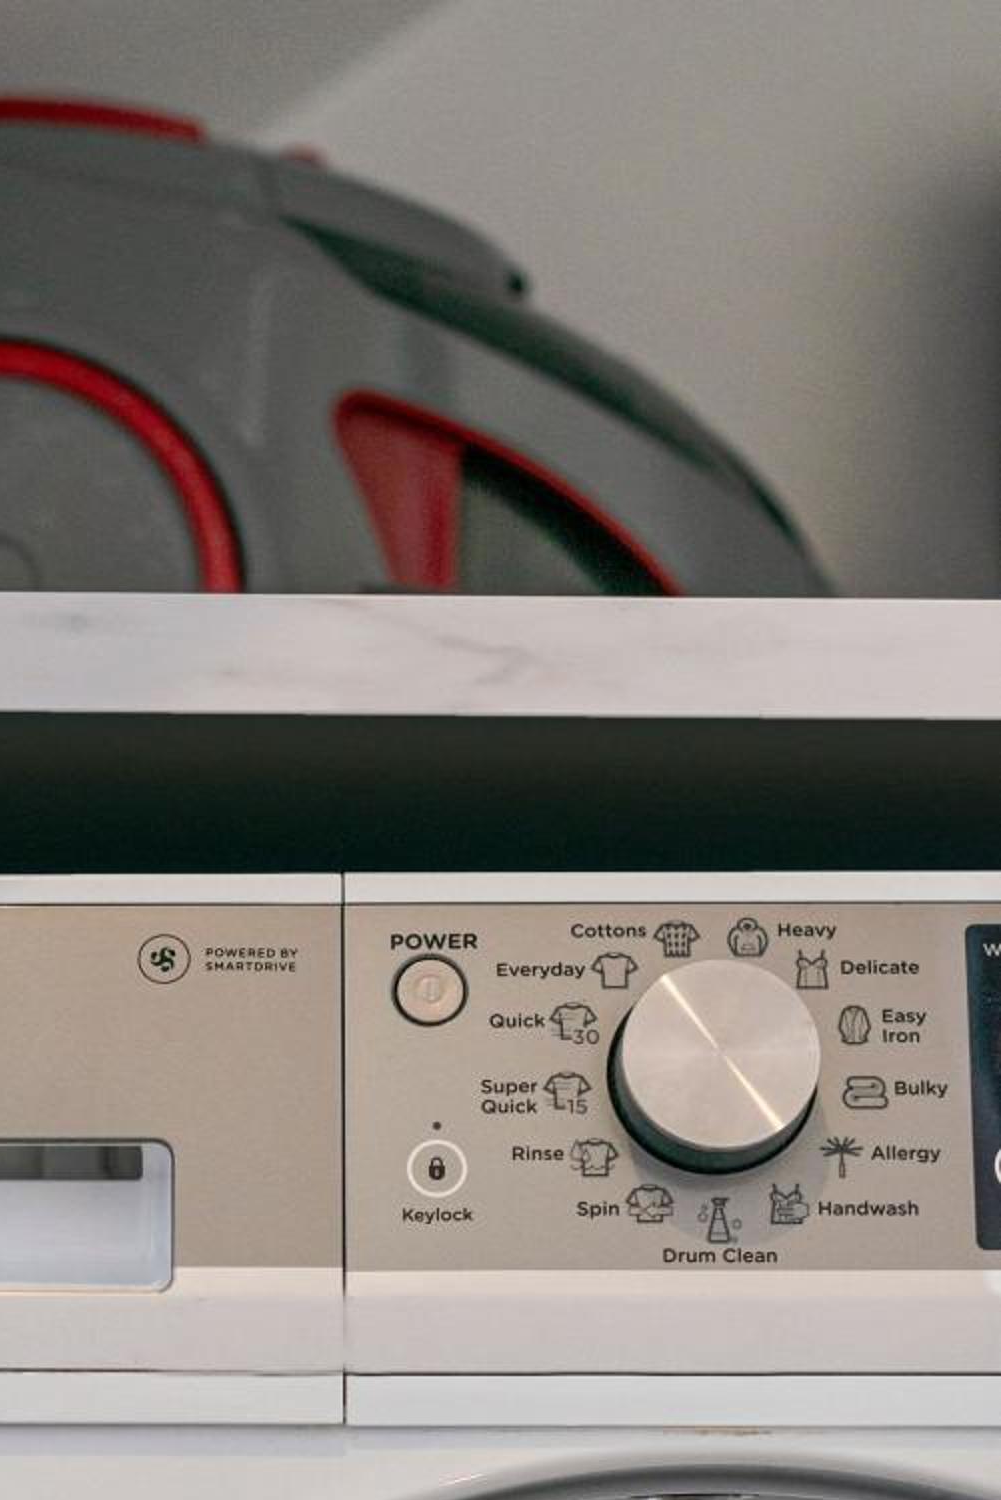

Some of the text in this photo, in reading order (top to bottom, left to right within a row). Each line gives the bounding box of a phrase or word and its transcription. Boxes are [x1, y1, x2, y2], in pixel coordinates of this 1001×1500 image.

[570, 923, 647, 939] Cottons
[778, 923, 837, 940] Heavy
[390, 933, 478, 950] POWER
[205, 947, 298, 959] POWERED BY
[205, 961, 296, 973] SMARTDRIVE
[496, 962, 586, 979] Everyday
[840, 960, 920, 976] Delicate
[489, 1013, 546, 1029] Quick
[882, 1008, 927, 1026] Easy
[573, 1029, 600, 1045] 30
[882, 1029, 921, 1044] Iron
[481, 1079, 537, 1096] Super
[894, 1081, 948, 1098] Bulky
[481, 1099, 538, 1115] Quick
[567, 1099, 588, 1115] 15
[511, 1146, 565, 1161] Rinse
[871, 1145, 941, 1163] Allergy
[402, 1208, 473, 1224] Keylock
[577, 1201, 620, 1218] Spin
[818, 1201, 919, 1217] Handwash
[663, 1248, 778, 1264] Drum Clean
